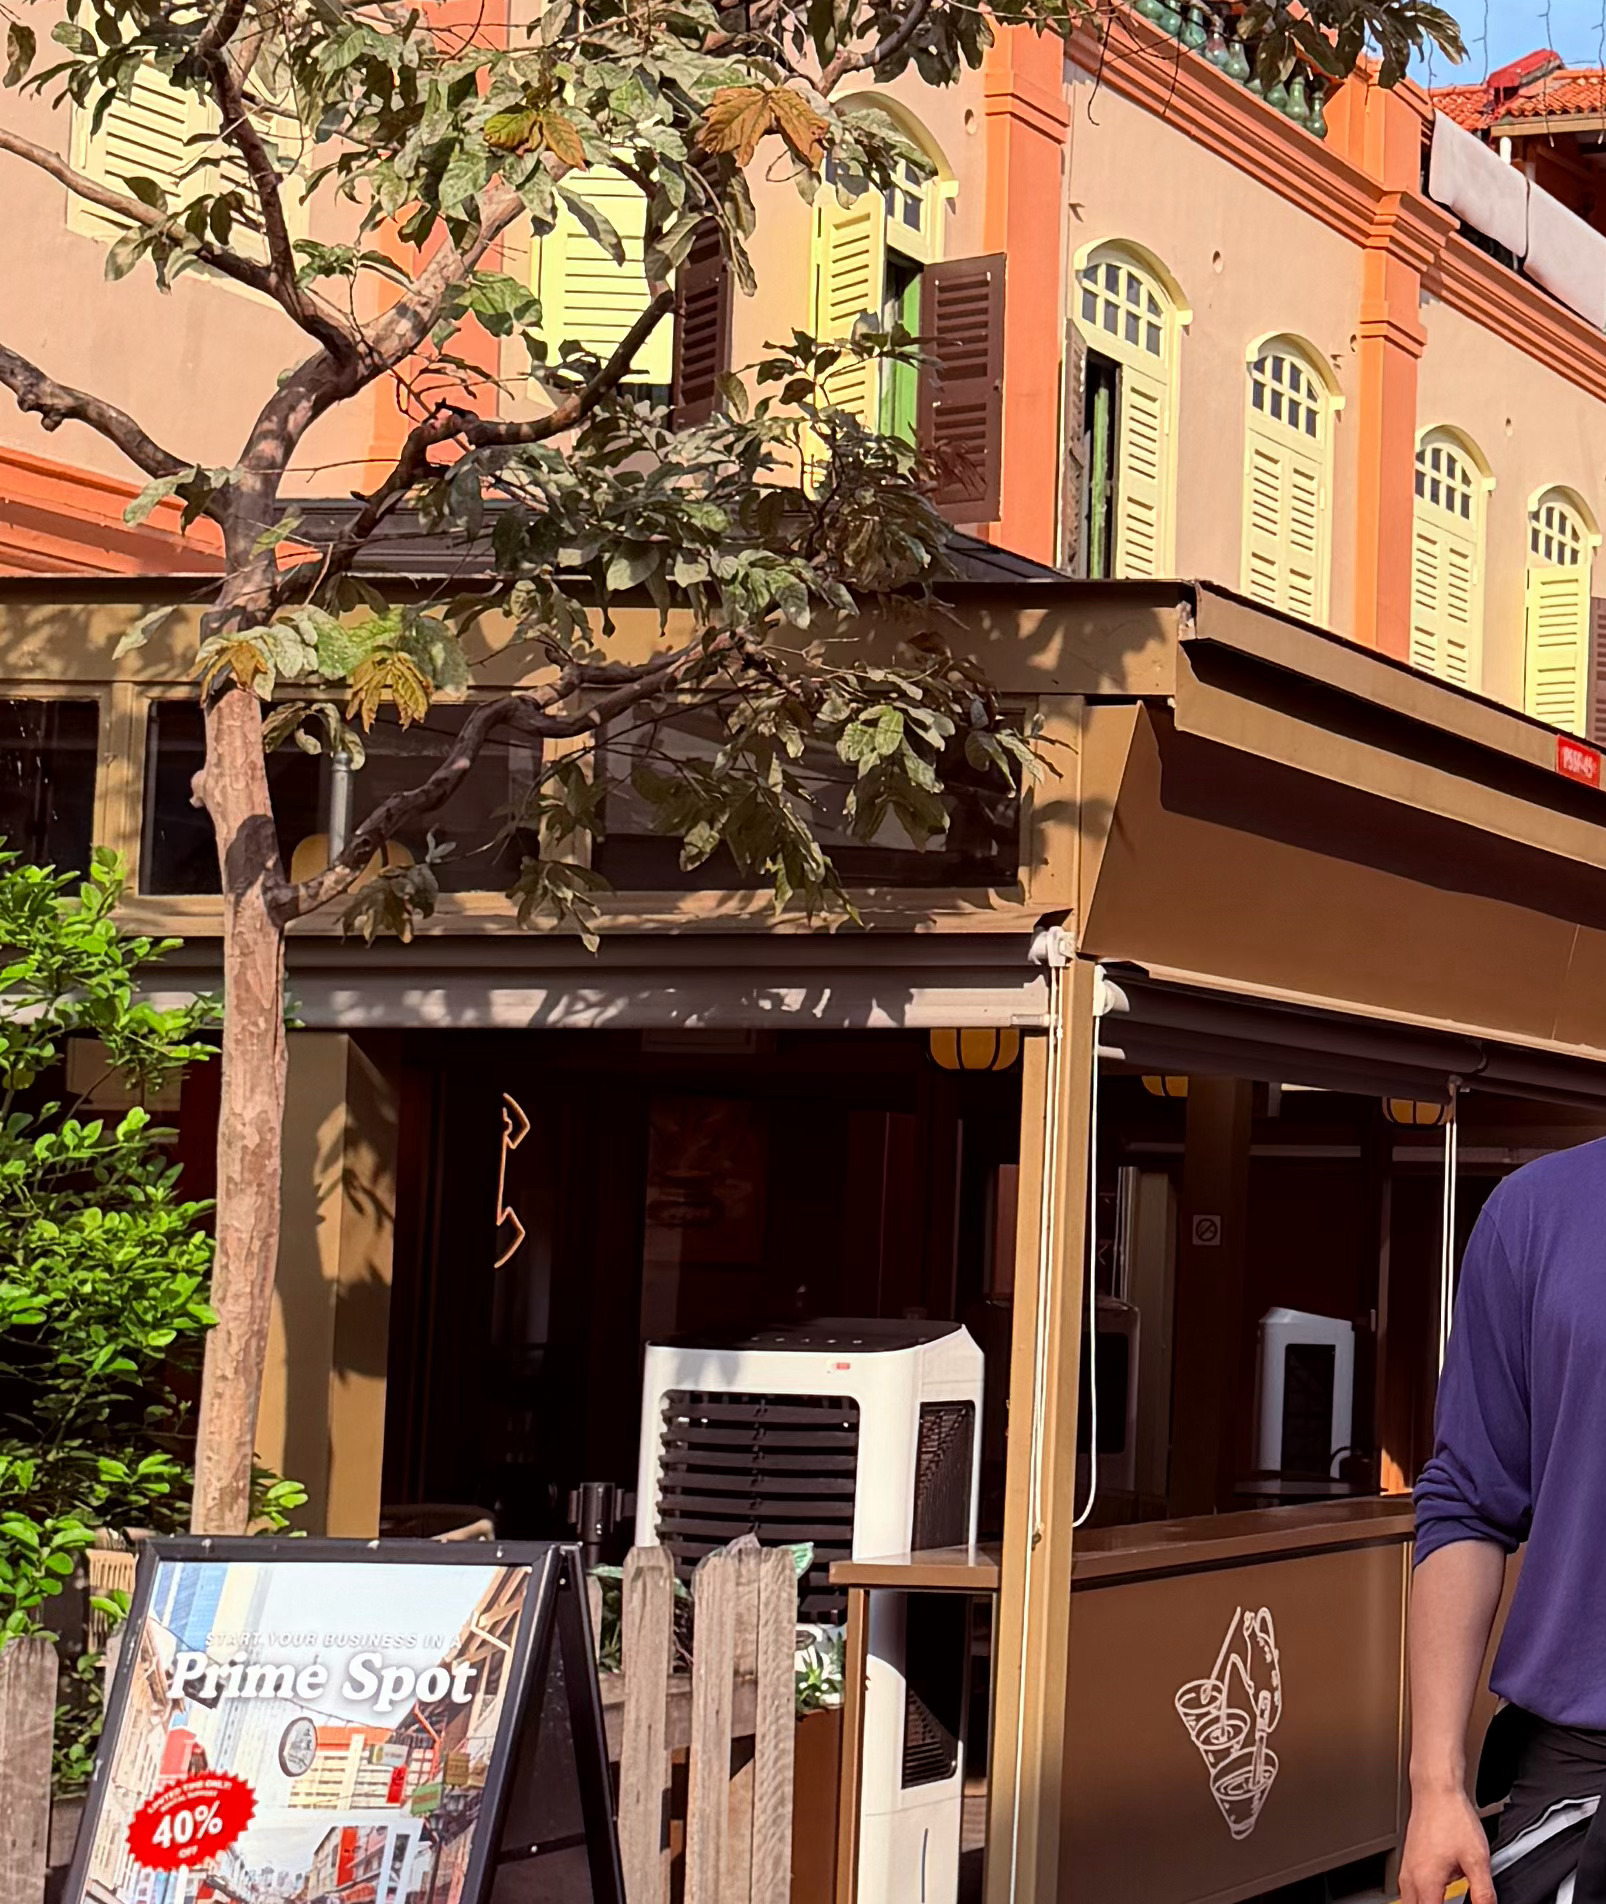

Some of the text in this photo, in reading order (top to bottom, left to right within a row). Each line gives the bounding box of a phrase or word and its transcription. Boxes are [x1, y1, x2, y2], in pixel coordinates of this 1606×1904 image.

[205, 1632, 462, 1648] START YOUR BUSINESS IN A
[167, 1651, 478, 1713] Prime Spot
[151, 1800, 223, 1849] 40%
[177, 1845, 199, 1858] OFF
